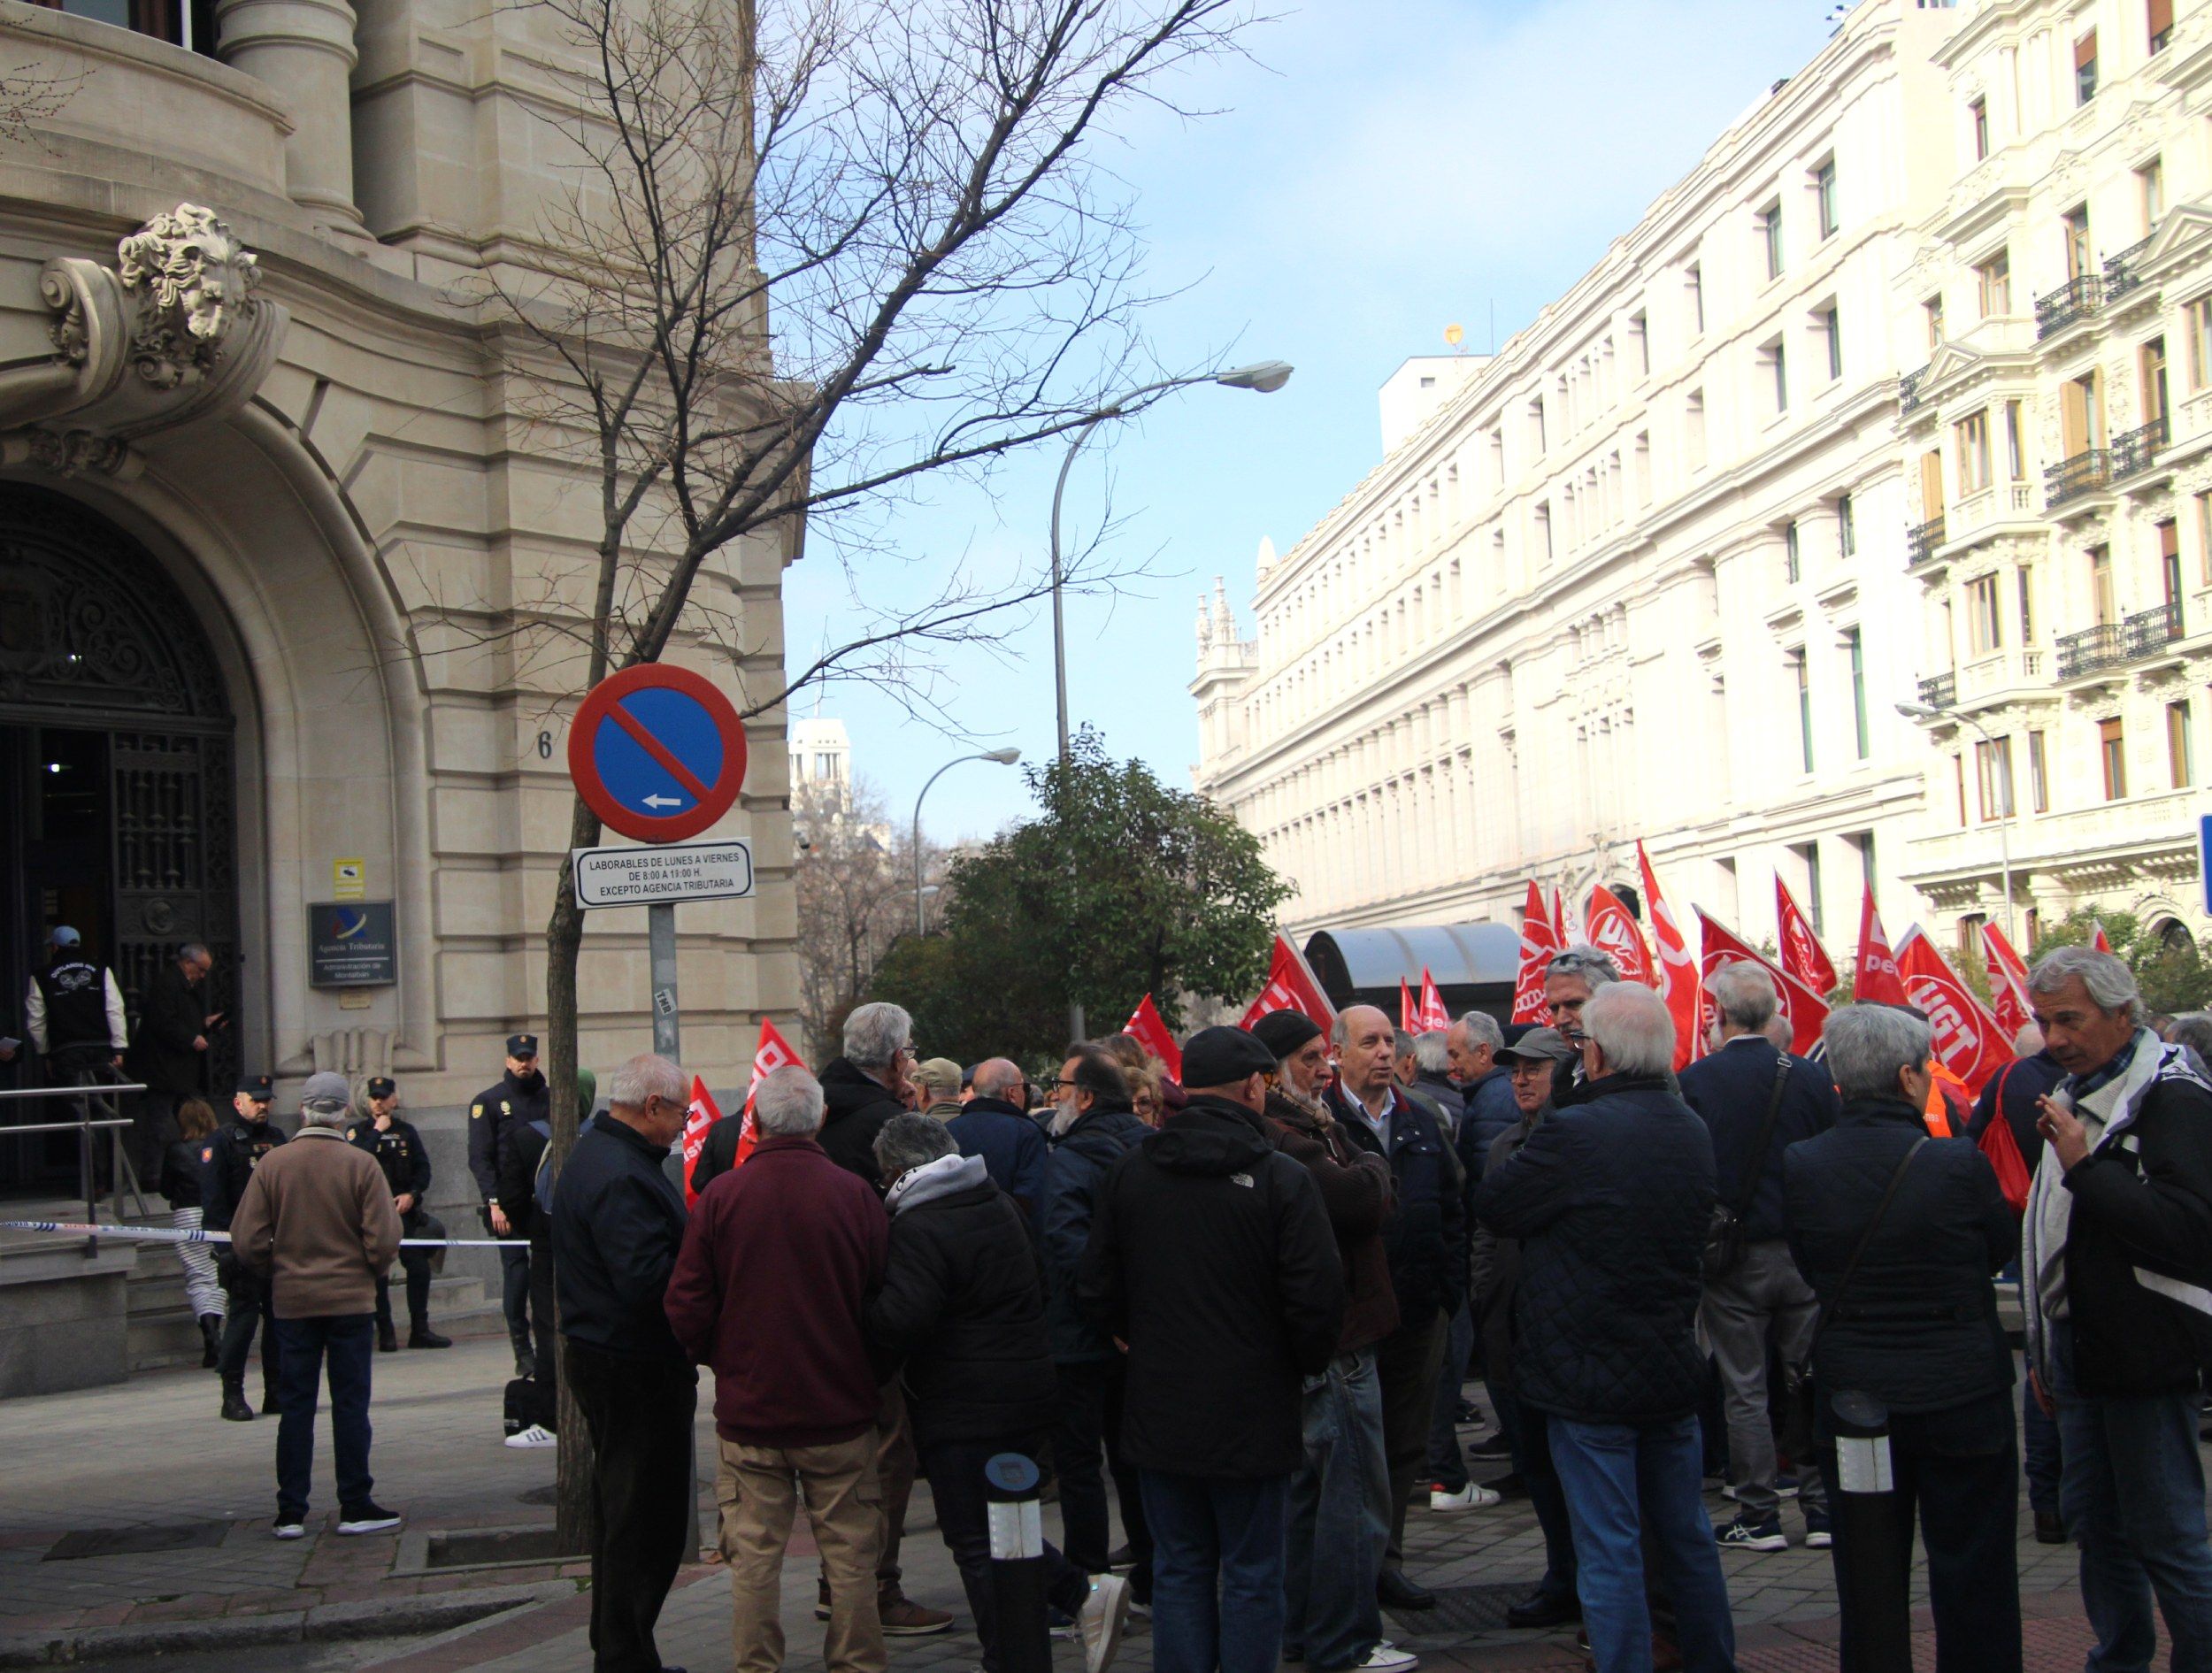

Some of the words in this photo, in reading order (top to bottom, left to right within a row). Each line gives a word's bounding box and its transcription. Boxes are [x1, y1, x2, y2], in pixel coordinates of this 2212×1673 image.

[538, 731, 552, 759] 6
[589, 859, 649, 871] LABORABLES
[650, 857, 663, 867] DE
[664, 856, 693, 866] LUNES
[695, 856, 702, 864] A
[703, 852, 740, 863] VIERNES
[629, 871, 641, 881] DE
[642, 871, 660, 880] 8:00
[662, 870, 669, 879] A
[600, 885, 641, 896] EXCEPTO
[642, 882, 682, 894] AGENCIA
[683, 879, 734, 890] TRIBUTARIA
[349, 942, 385, 951] Tributaria
[1910, 980, 1978, 1068] UGT
